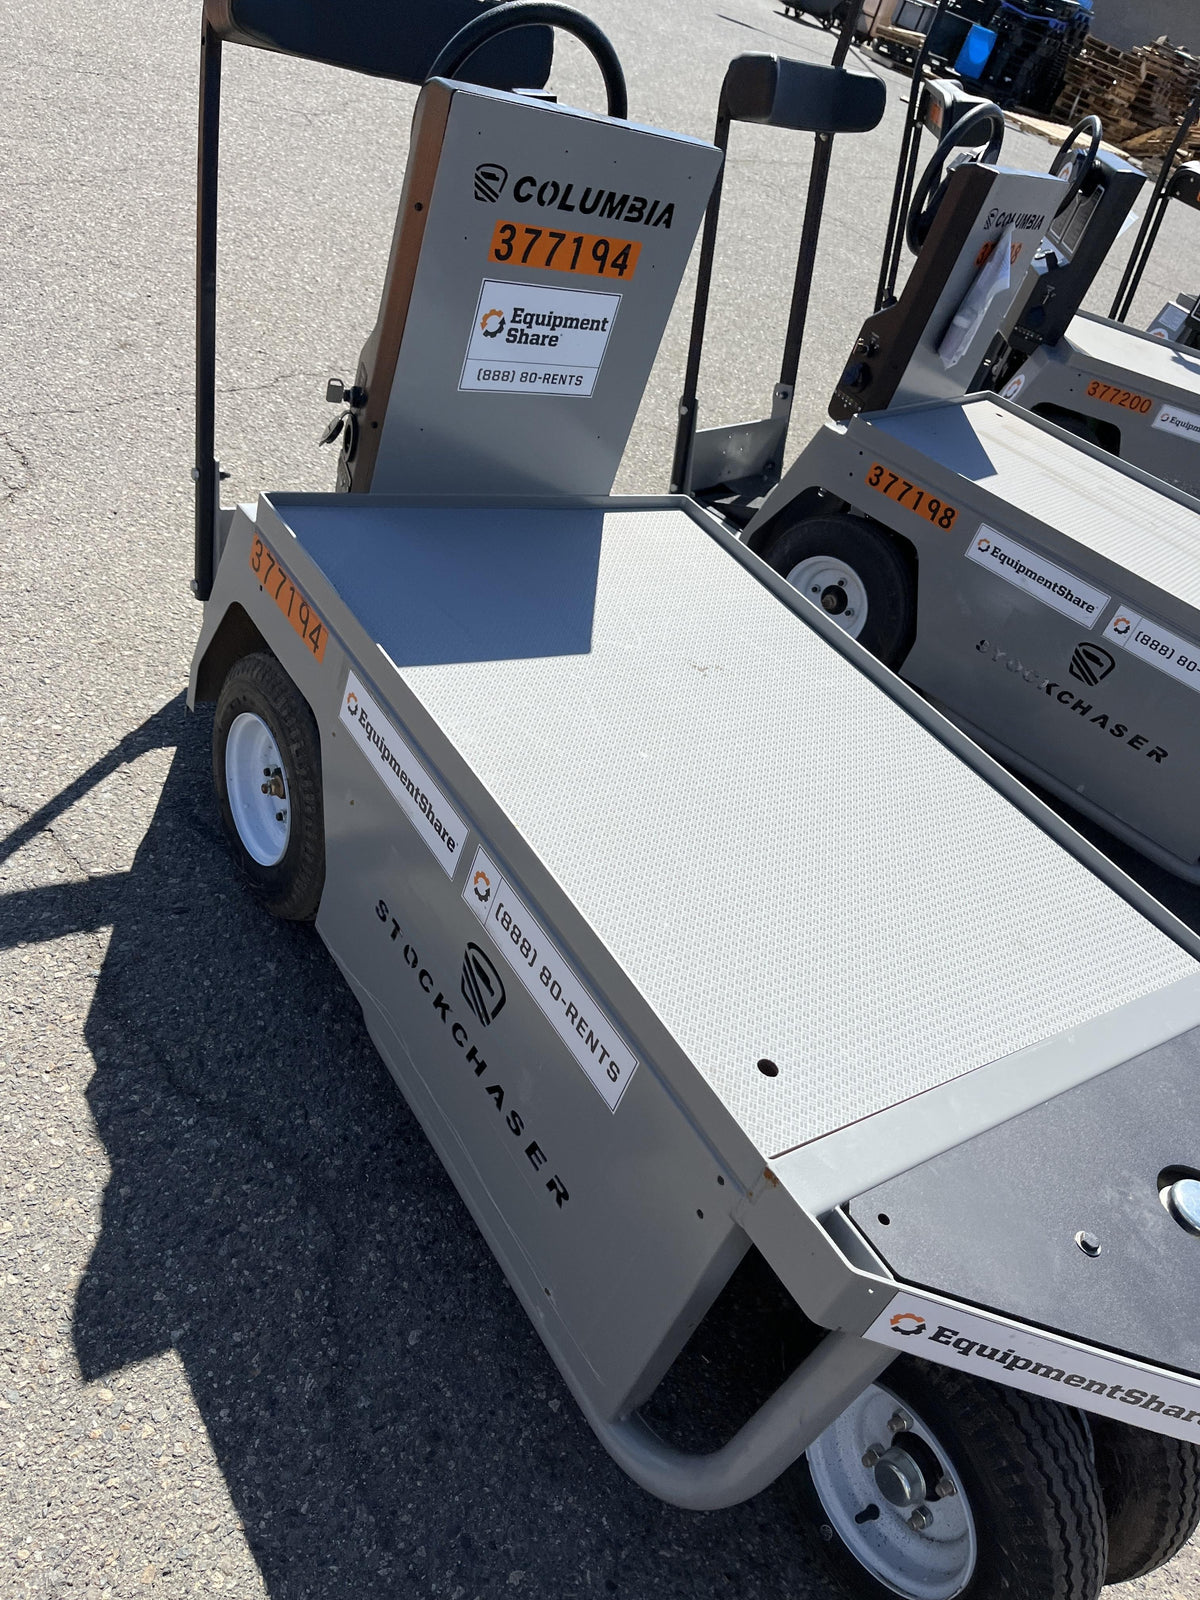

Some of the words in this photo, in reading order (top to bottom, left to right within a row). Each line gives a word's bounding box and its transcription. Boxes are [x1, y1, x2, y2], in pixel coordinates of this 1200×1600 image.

[513, 176, 676, 229] COLUMBIA
[494, 224, 632, 276] 377194
[505, 328, 559, 347] Share
[510, 307, 609, 332] Equipment
[477, 367, 516, 383] (888)
[519, 369, 584, 386] 80-RENTS
[1087, 381, 1152, 413] 377200
[868, 466, 956, 530] 377198
[251, 540, 324, 654] 377194
[990, 545, 1096, 614] EquipmentShare
[1134, 631, 1176, 660] (888)
[357, 708, 456, 853] EquipmentShare
[494, 902, 539, 968] (888)
[539, 965, 621, 1083] 80-RENTS
[374, 899, 570, 1210] STOCKCHASER
